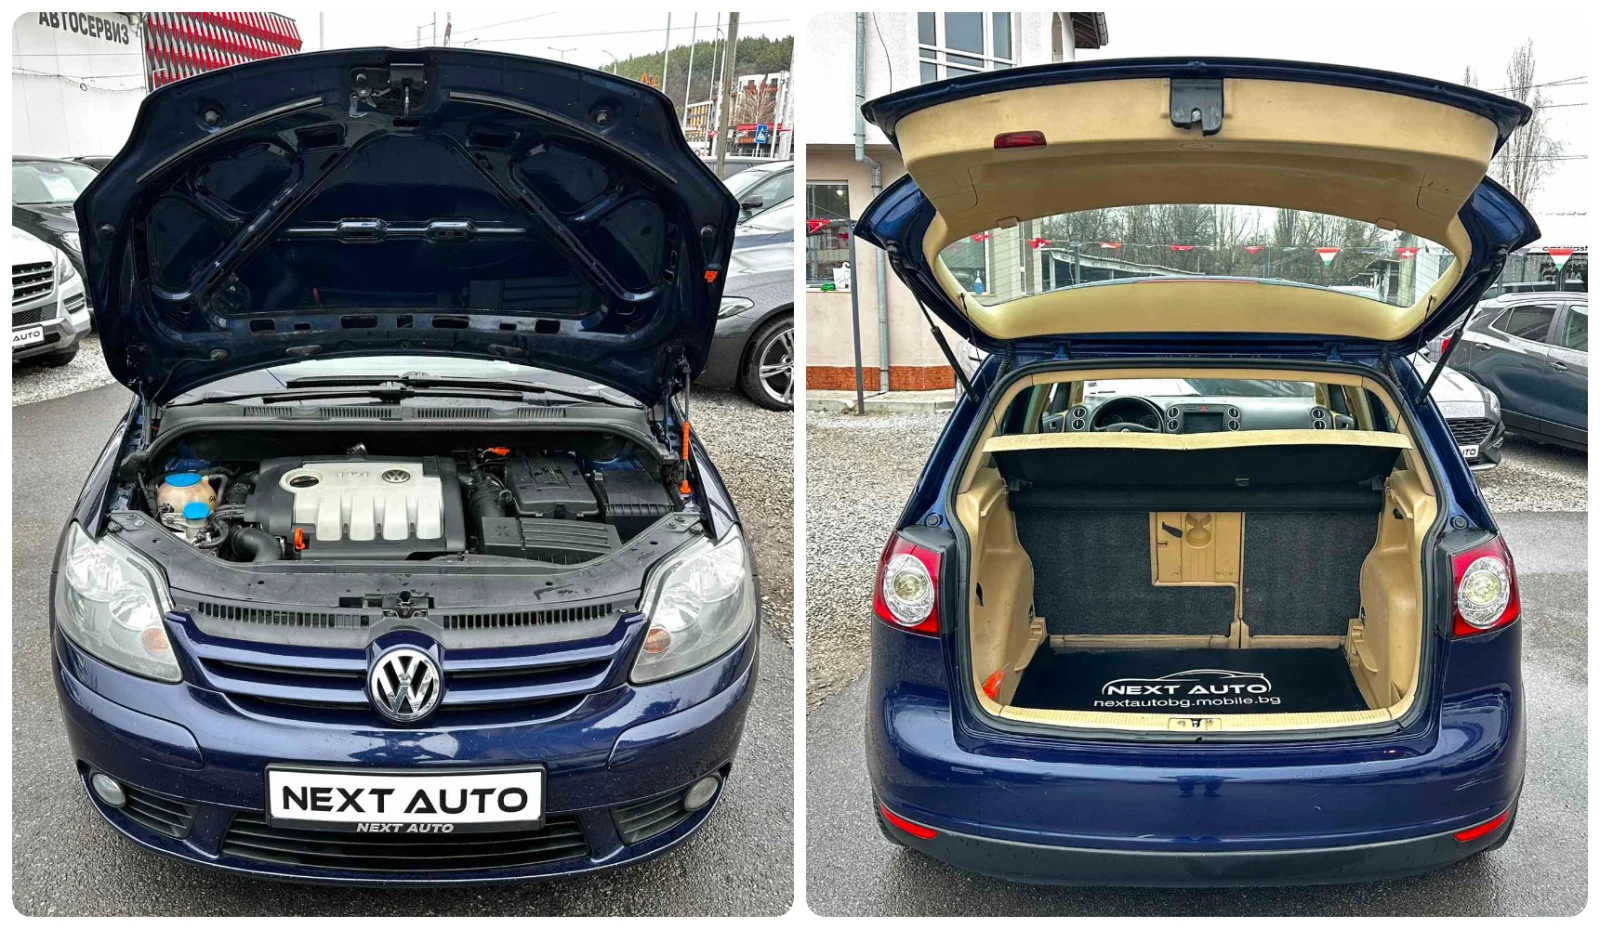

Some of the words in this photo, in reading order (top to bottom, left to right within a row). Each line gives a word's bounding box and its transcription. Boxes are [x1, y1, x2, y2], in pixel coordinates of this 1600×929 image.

[39, 12, 129, 45] АВТОСЕРВИЗ
[13, 331, 41, 341] AUTO
[1107, 684, 1181, 696] NEXT
[1187, 684, 1268, 695] AUTO
[1093, 696, 1281, 708] nextautobg.mobile.bg
[282, 785, 395, 813] NEXT
[403, 786, 528, 814] AUTO
[356, 822, 404, 833] NEXT
[406, 823, 454, 833] AUTO
